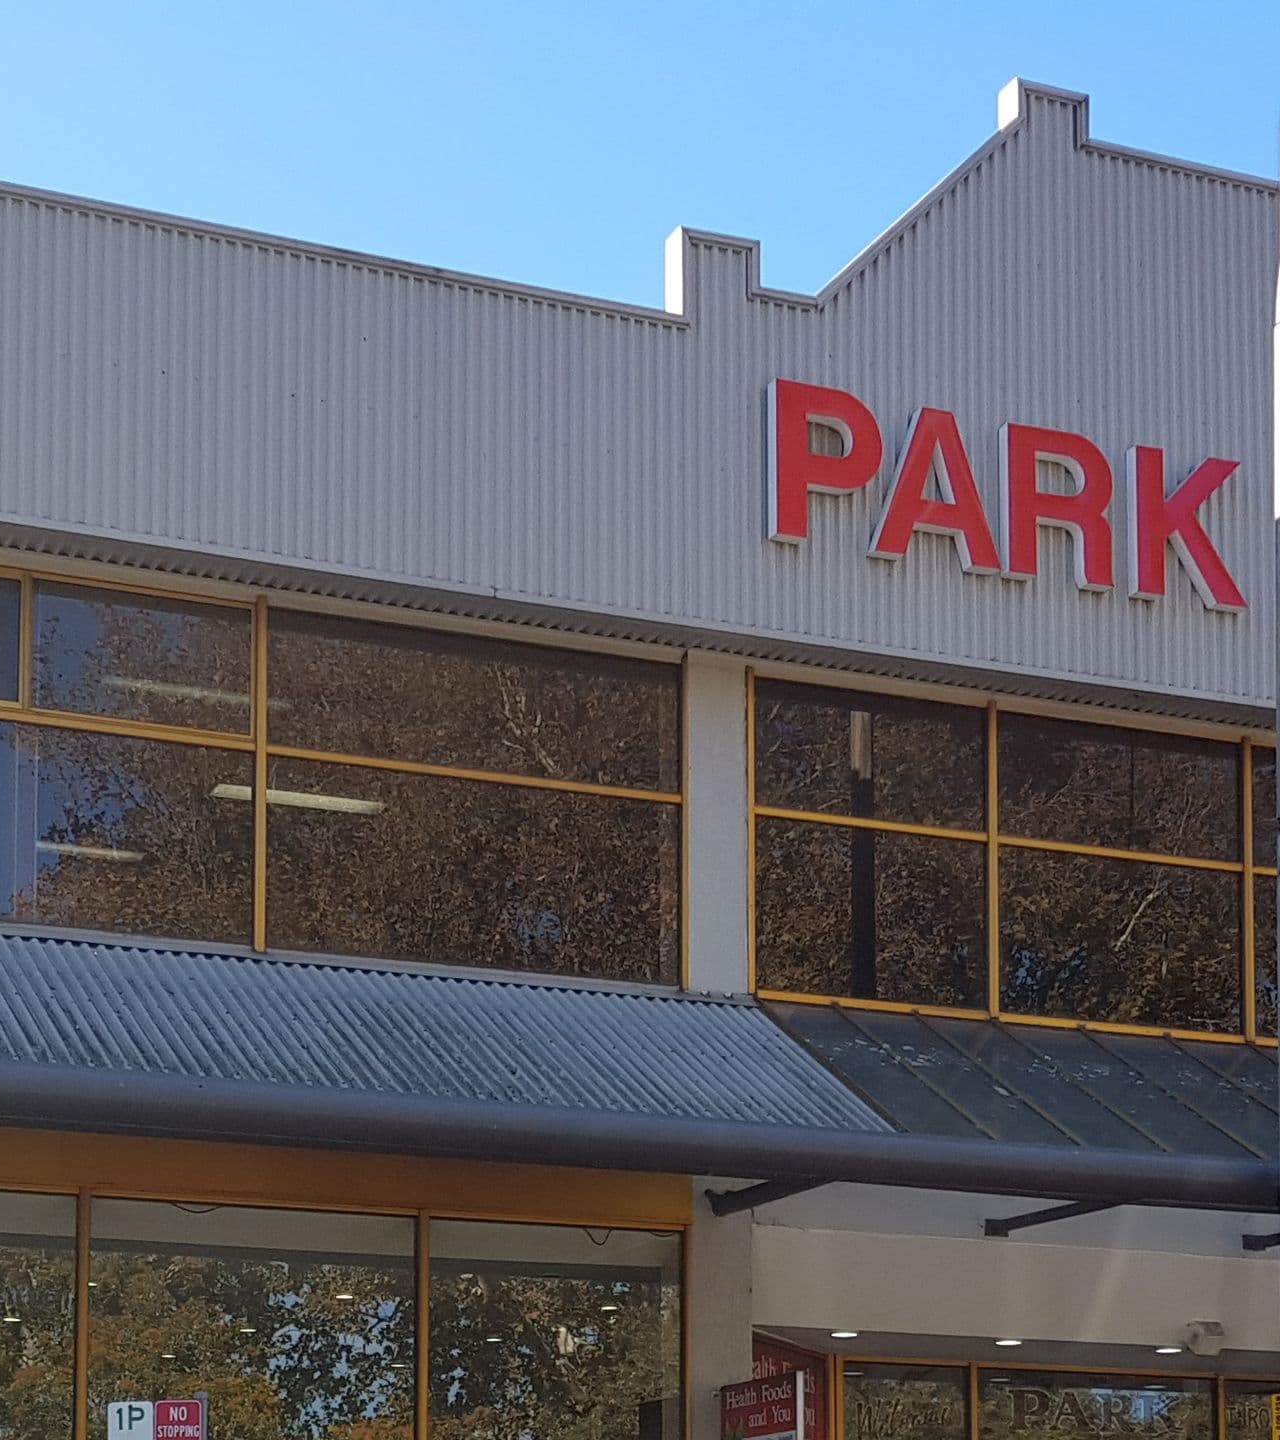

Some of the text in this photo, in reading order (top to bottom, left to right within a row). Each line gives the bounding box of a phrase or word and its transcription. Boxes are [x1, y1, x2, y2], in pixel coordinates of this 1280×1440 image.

[767, 378, 1248, 613] PARK
[726, 1380, 792, 1410] Health Foods
[116, 1404, 145, 1431] 1P
[168, 1406, 188, 1421] NO
[748, 1404, 791, 1428] and You
[1007, 1386, 1183, 1435] PARK
[157, 1424, 200, 1438] STOPPING
